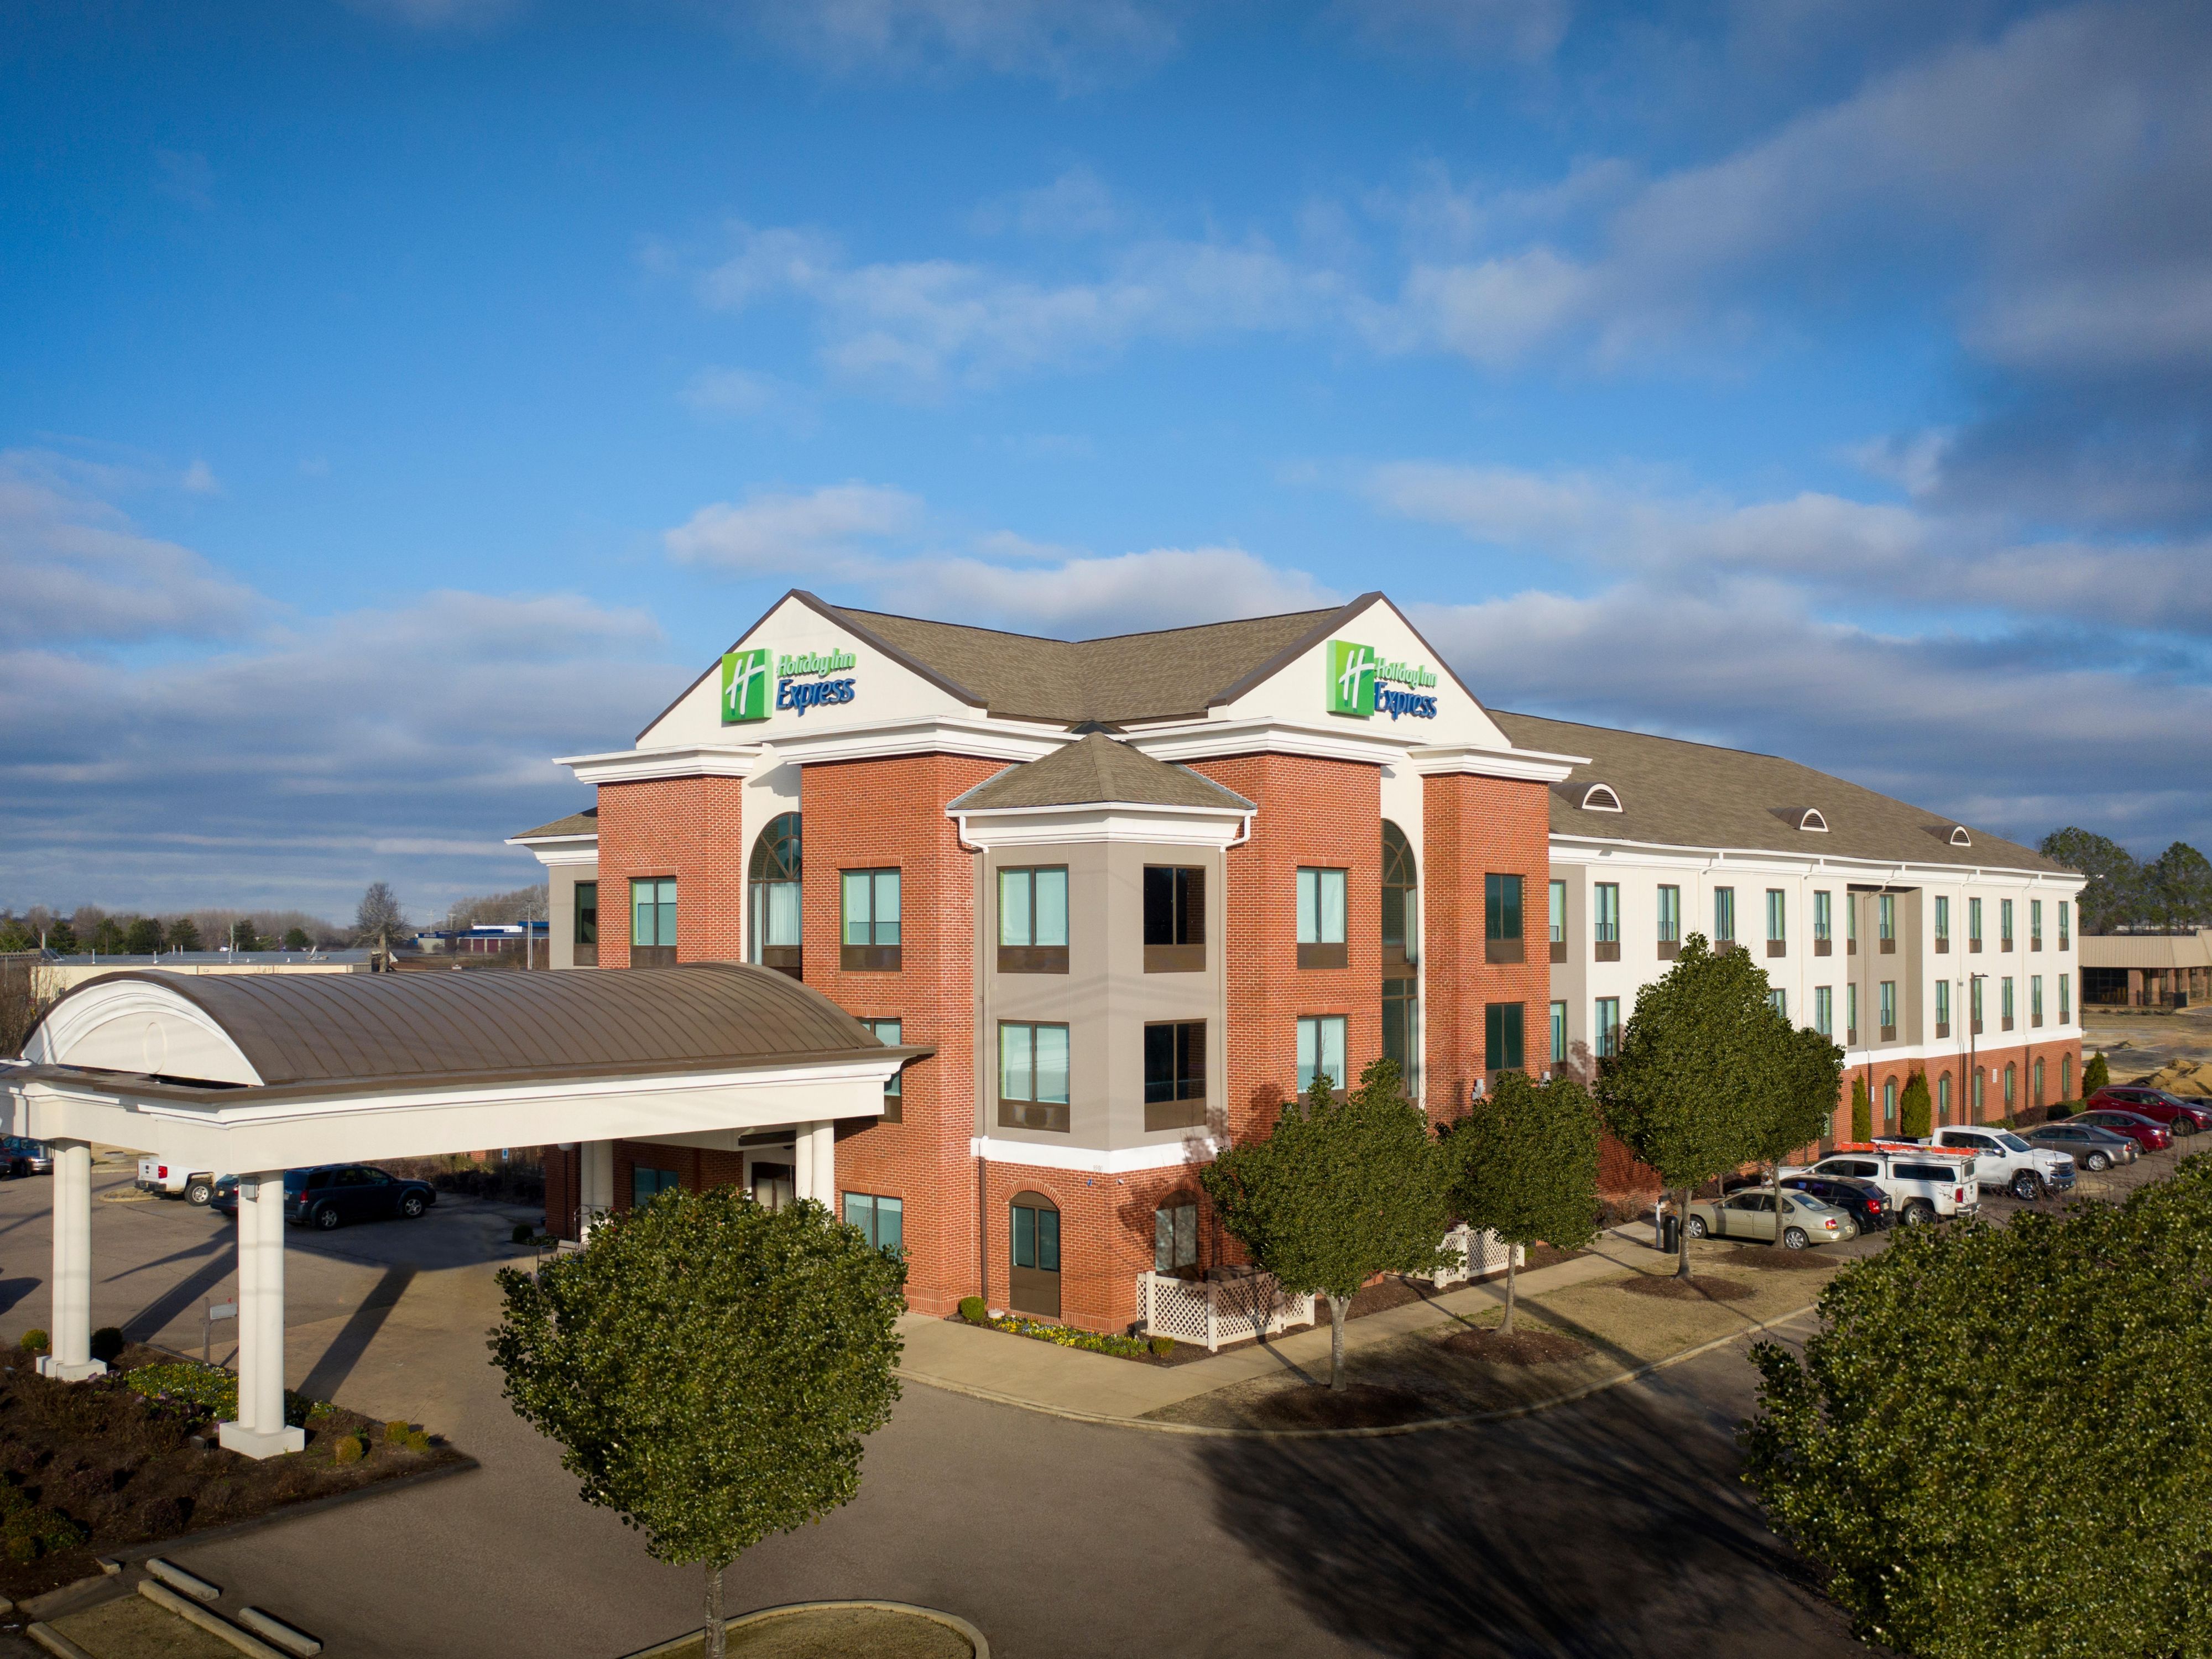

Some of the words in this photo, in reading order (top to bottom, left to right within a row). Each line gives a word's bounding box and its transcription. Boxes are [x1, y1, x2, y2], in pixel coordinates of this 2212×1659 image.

[776, 651, 832, 677] Holiday
[831, 648, 856, 670] Inn
[1375, 658, 1420, 689] Holiday
[1418, 665, 1437, 687] Inn
[776, 678, 856, 716] Express
[1375, 681, 1437, 721] Express
